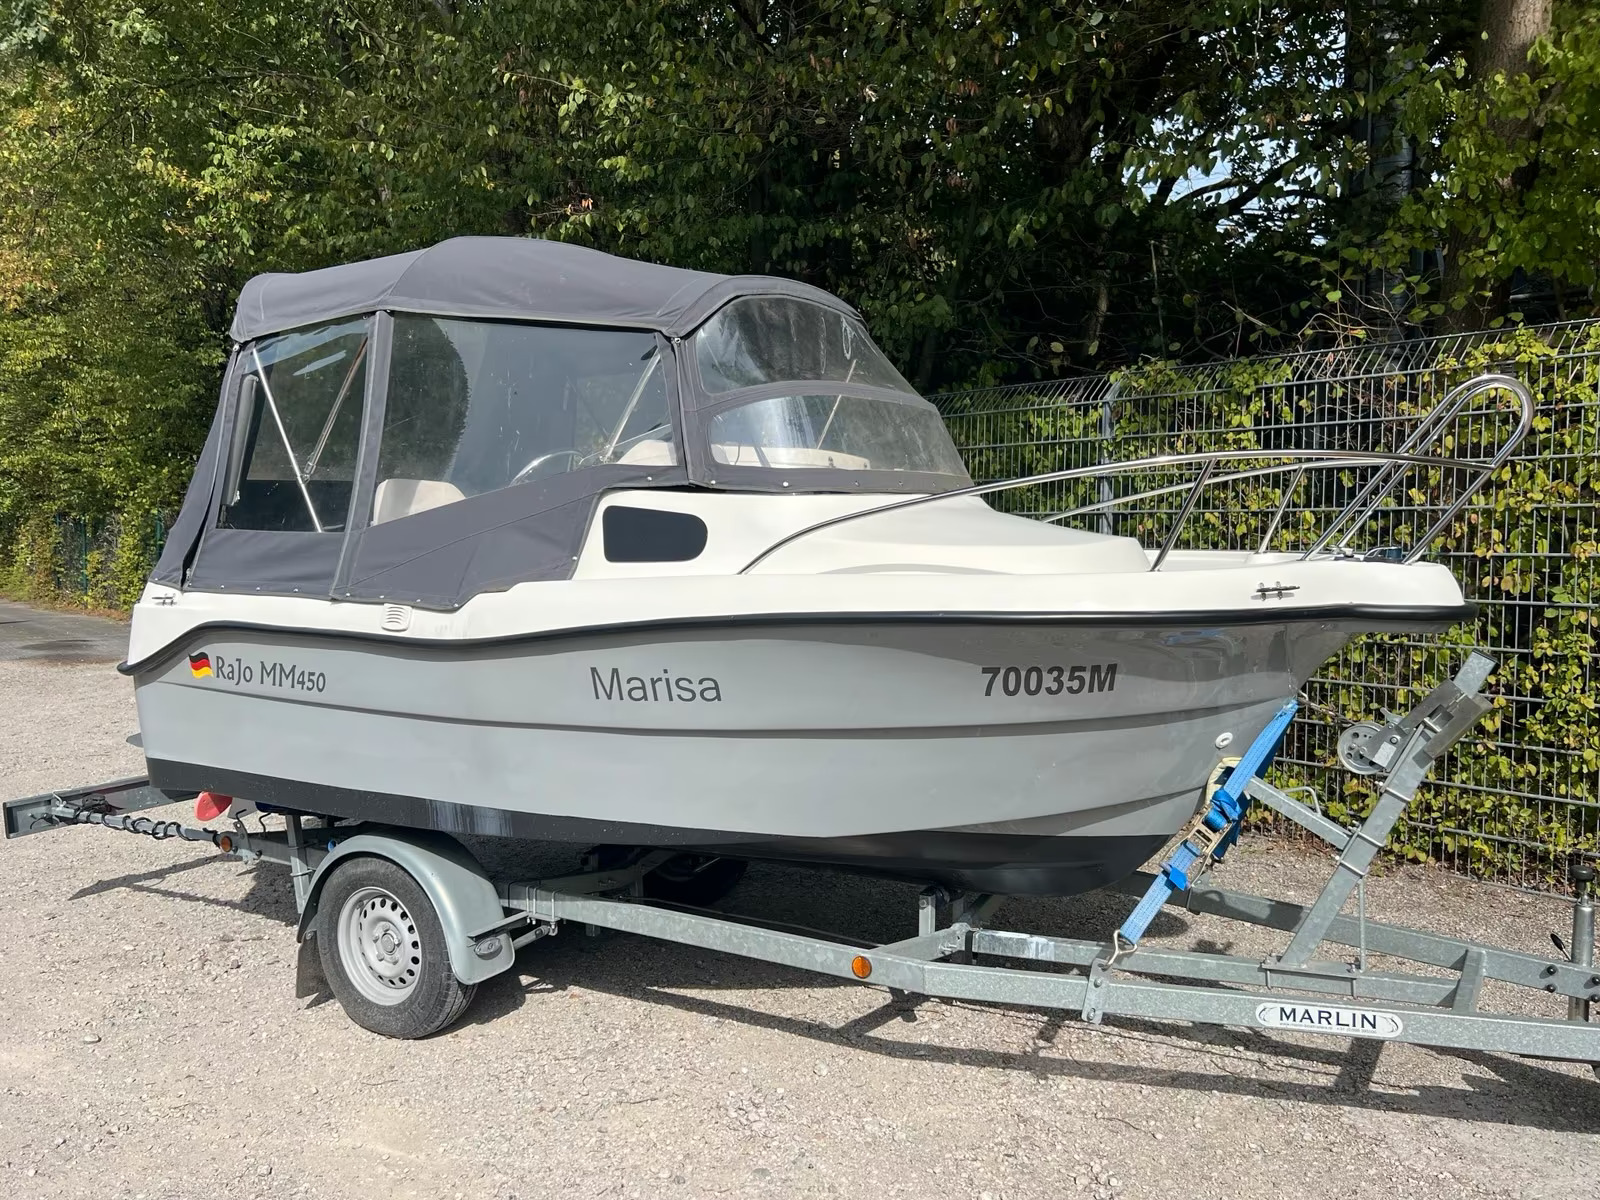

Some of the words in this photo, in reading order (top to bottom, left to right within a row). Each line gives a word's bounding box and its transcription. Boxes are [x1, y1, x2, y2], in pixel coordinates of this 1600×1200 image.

[215, 655, 253, 686] RaJo
[260, 660, 326, 693] MM450
[590, 666, 722, 702] Marisa
[981, 663, 1118, 697] 70035M
[1279, 1006, 1377, 1029] MARLIN
